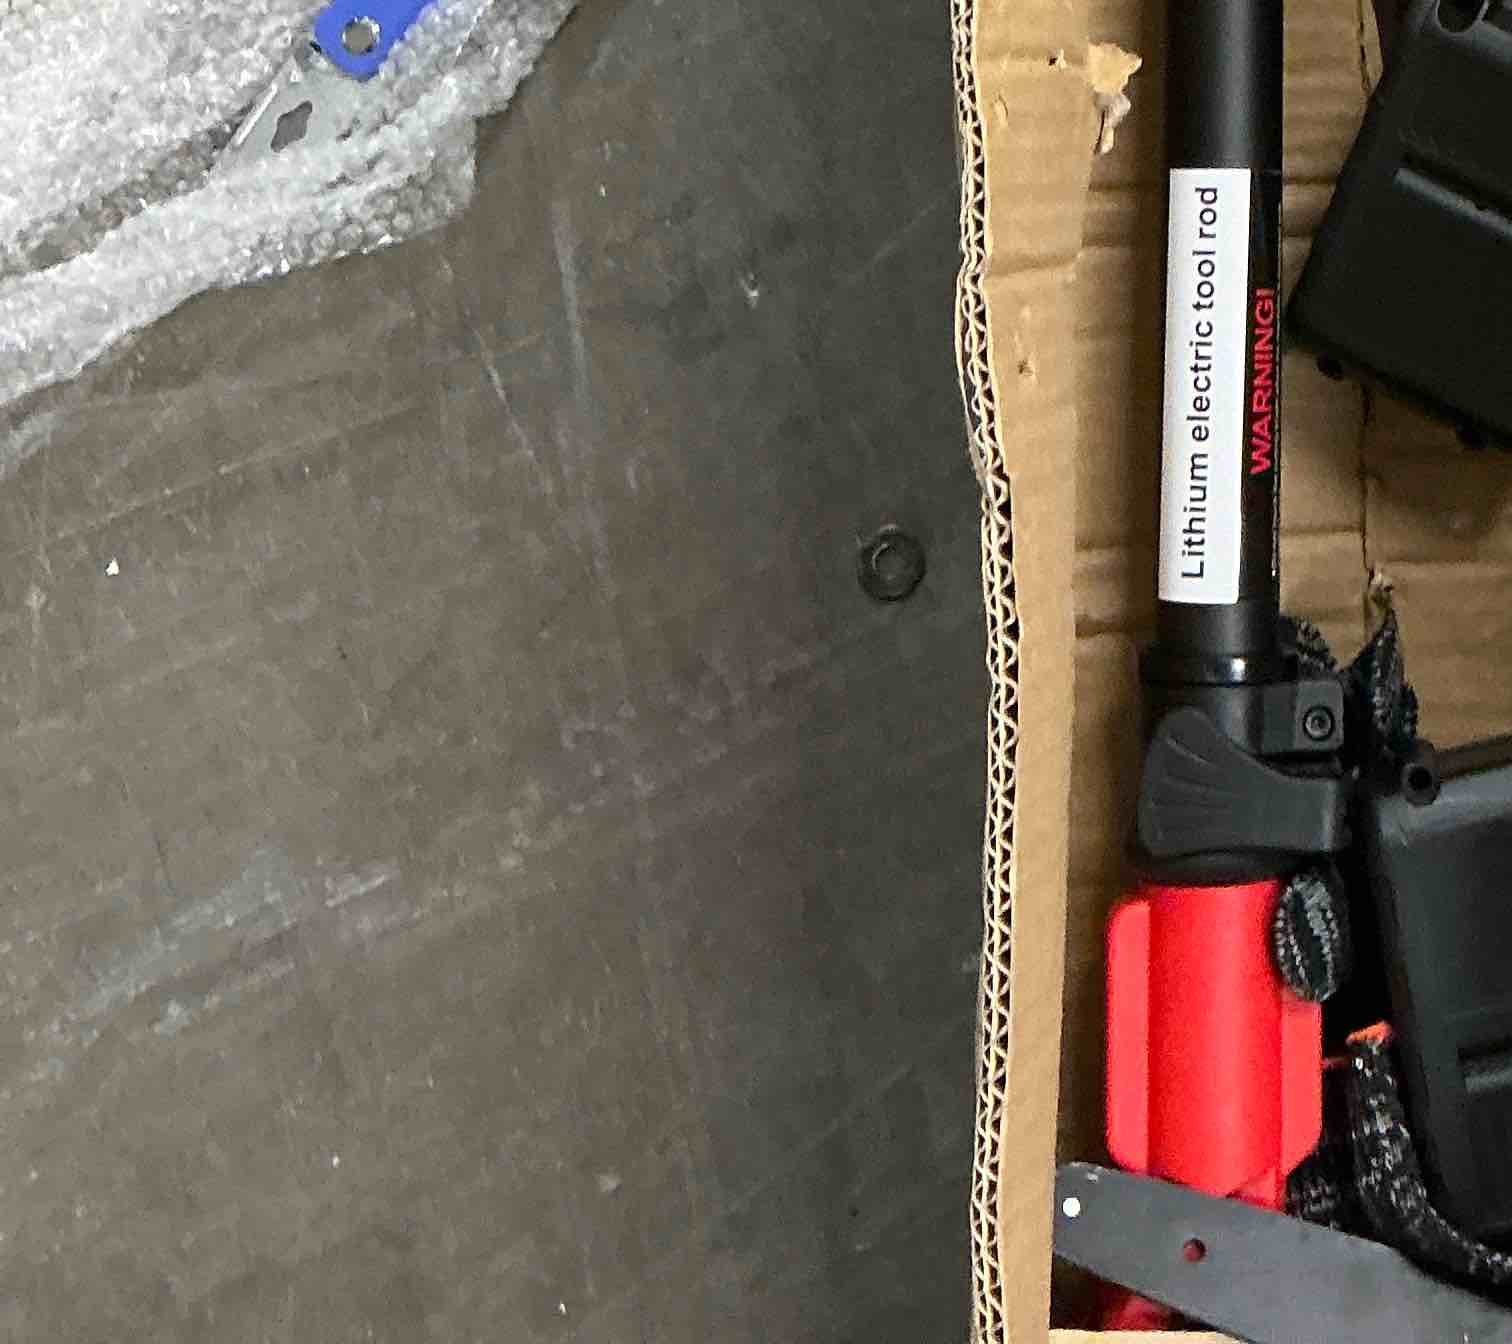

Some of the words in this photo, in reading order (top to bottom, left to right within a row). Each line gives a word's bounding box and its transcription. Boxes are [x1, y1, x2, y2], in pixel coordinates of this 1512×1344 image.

[1194, 186, 1218, 239] rod
[1192, 248, 1216, 311] tool
[1187, 319, 1214, 442] electric
[1250, 287, 1276, 475] WARNING!
[1181, 452, 1209, 579] Lithium
